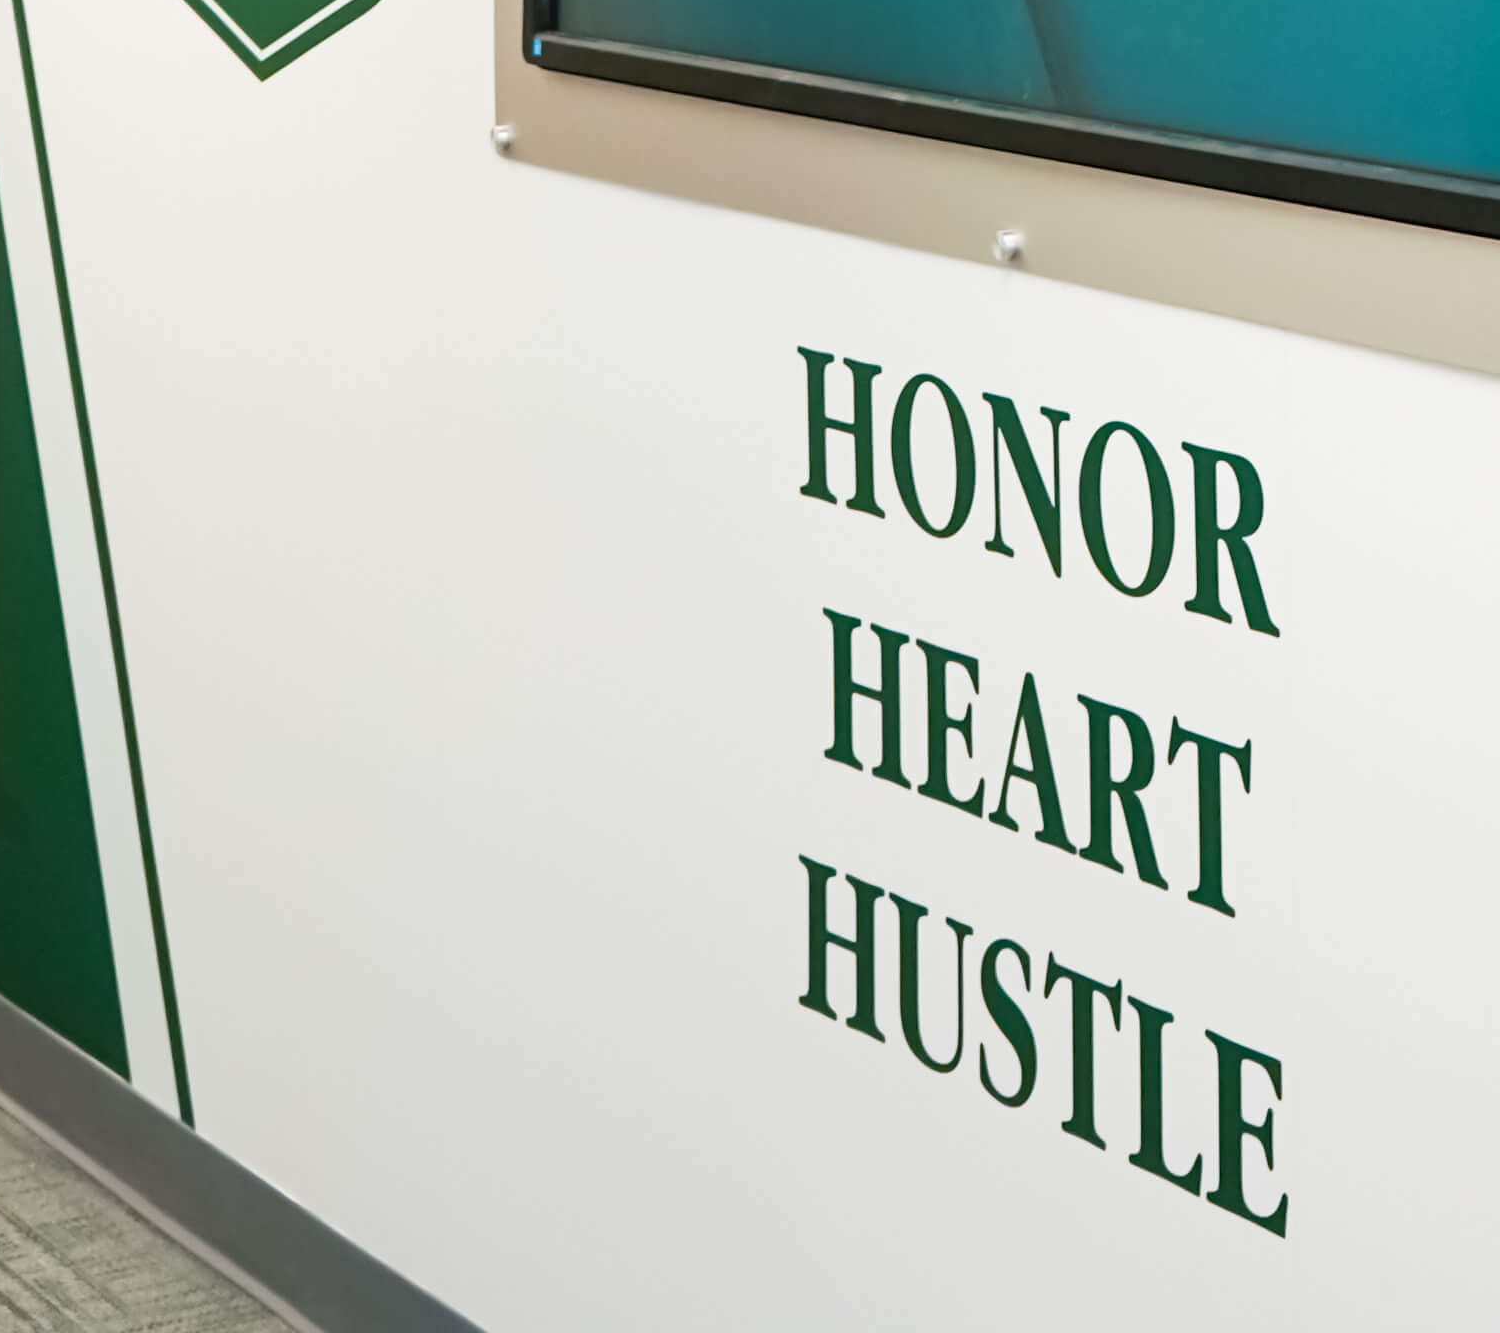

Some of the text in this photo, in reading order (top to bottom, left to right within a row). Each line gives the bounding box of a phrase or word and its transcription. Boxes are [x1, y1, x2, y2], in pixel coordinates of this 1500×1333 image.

[797, 346, 1280, 638] HONOR
[823, 607, 1252, 918] HEART
[798, 854, 1288, 1239] HUSTLE
